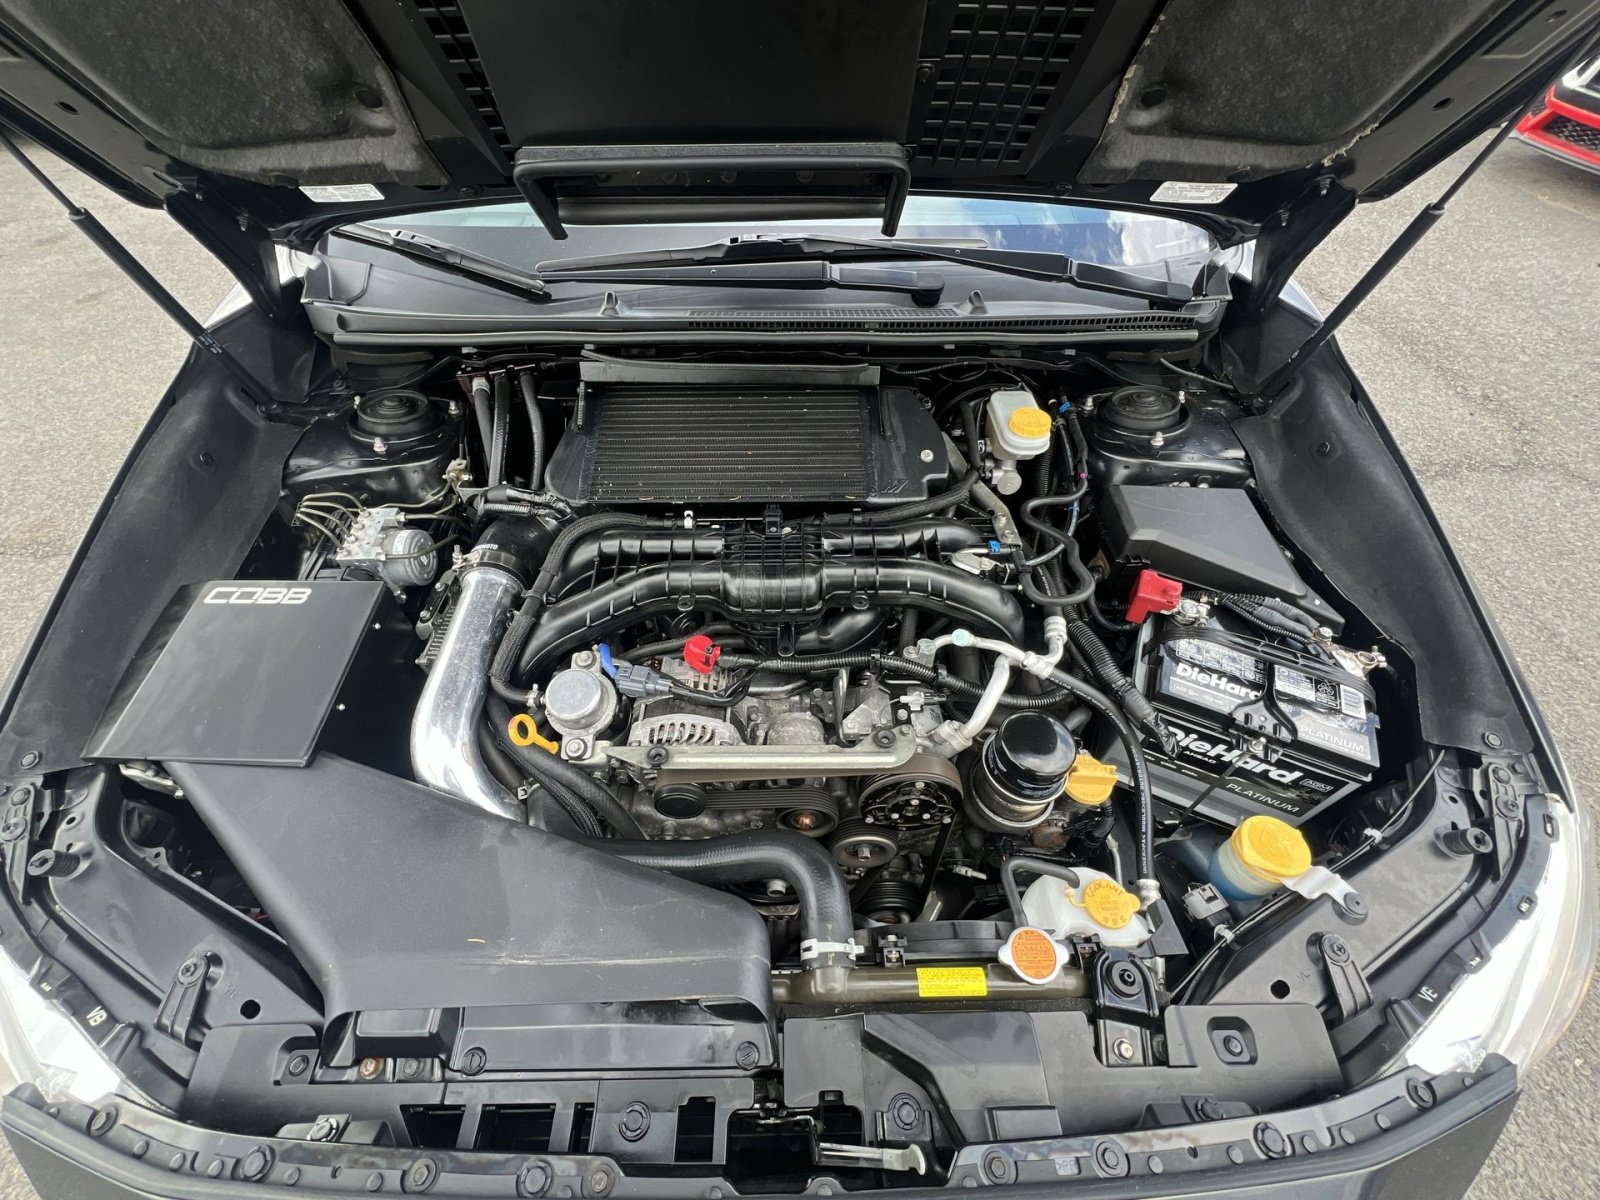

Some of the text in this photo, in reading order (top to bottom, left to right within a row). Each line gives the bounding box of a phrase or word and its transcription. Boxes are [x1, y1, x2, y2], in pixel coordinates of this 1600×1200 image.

[203, 587, 312, 604] COBB
[1300, 726, 1364, 752] PLATINUM
[1226, 783, 1300, 813] PLATINUM
[86, 1005, 107, 1026] VB
